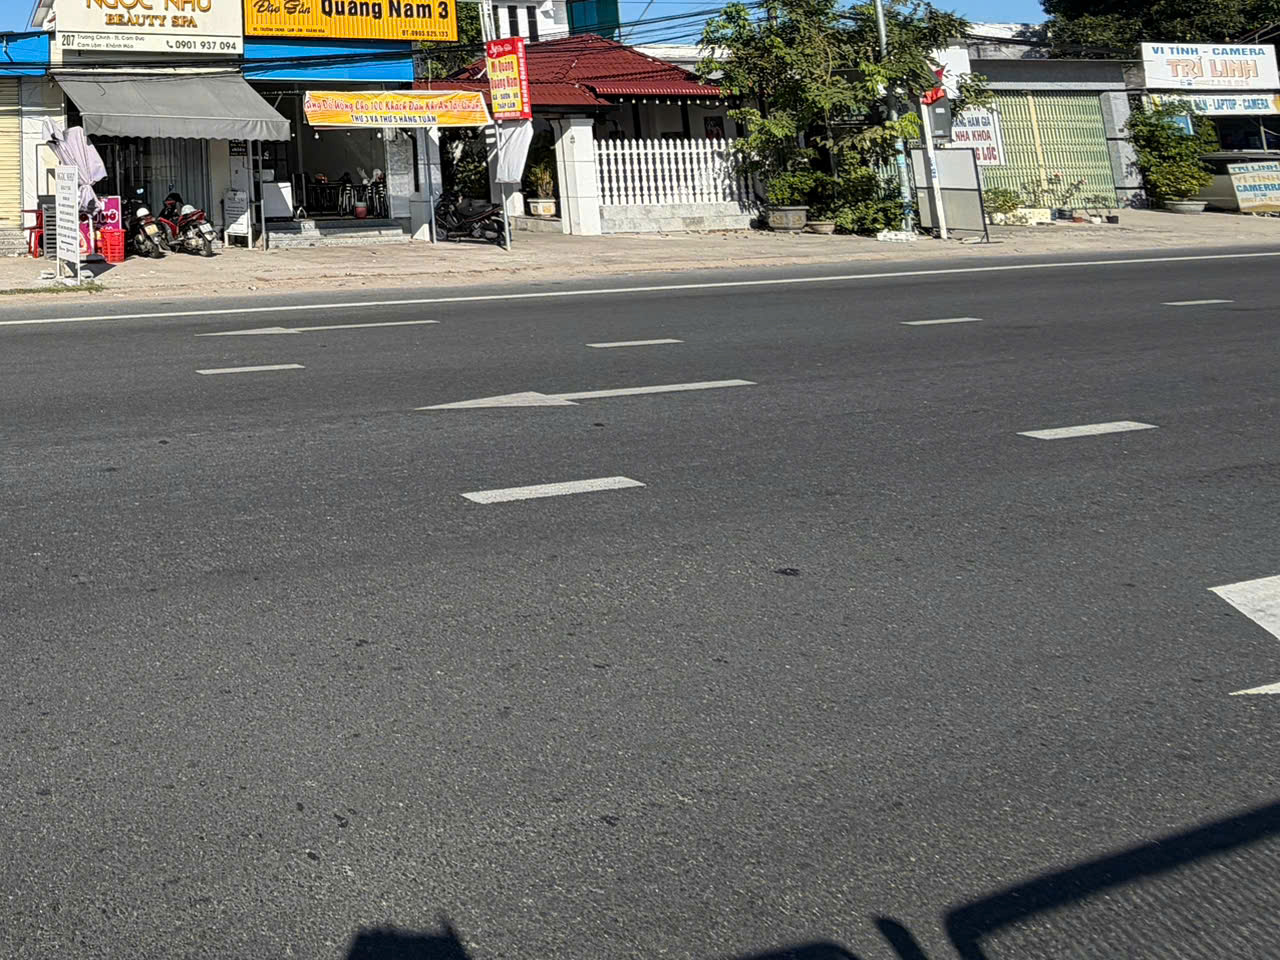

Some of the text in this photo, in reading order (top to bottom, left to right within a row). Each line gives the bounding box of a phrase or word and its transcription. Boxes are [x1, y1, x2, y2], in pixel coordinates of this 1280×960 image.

[389, 0, 432, 19] Nam
[437, 1, 449, 20] 3
[105, 13, 198, 28] BEAUTY SPA
[62, 34, 75, 46] 207
[175, 41, 236, 51] 0901 937 094
[1152, 45, 1266, 56] VI TÍNH CAMERA
[1166, 56, 1259, 79] TRÍ LINH
[1213, 98, 1270, 111] LAPTOP CAMERA
[955, 130, 992, 142] NHA KHOA
